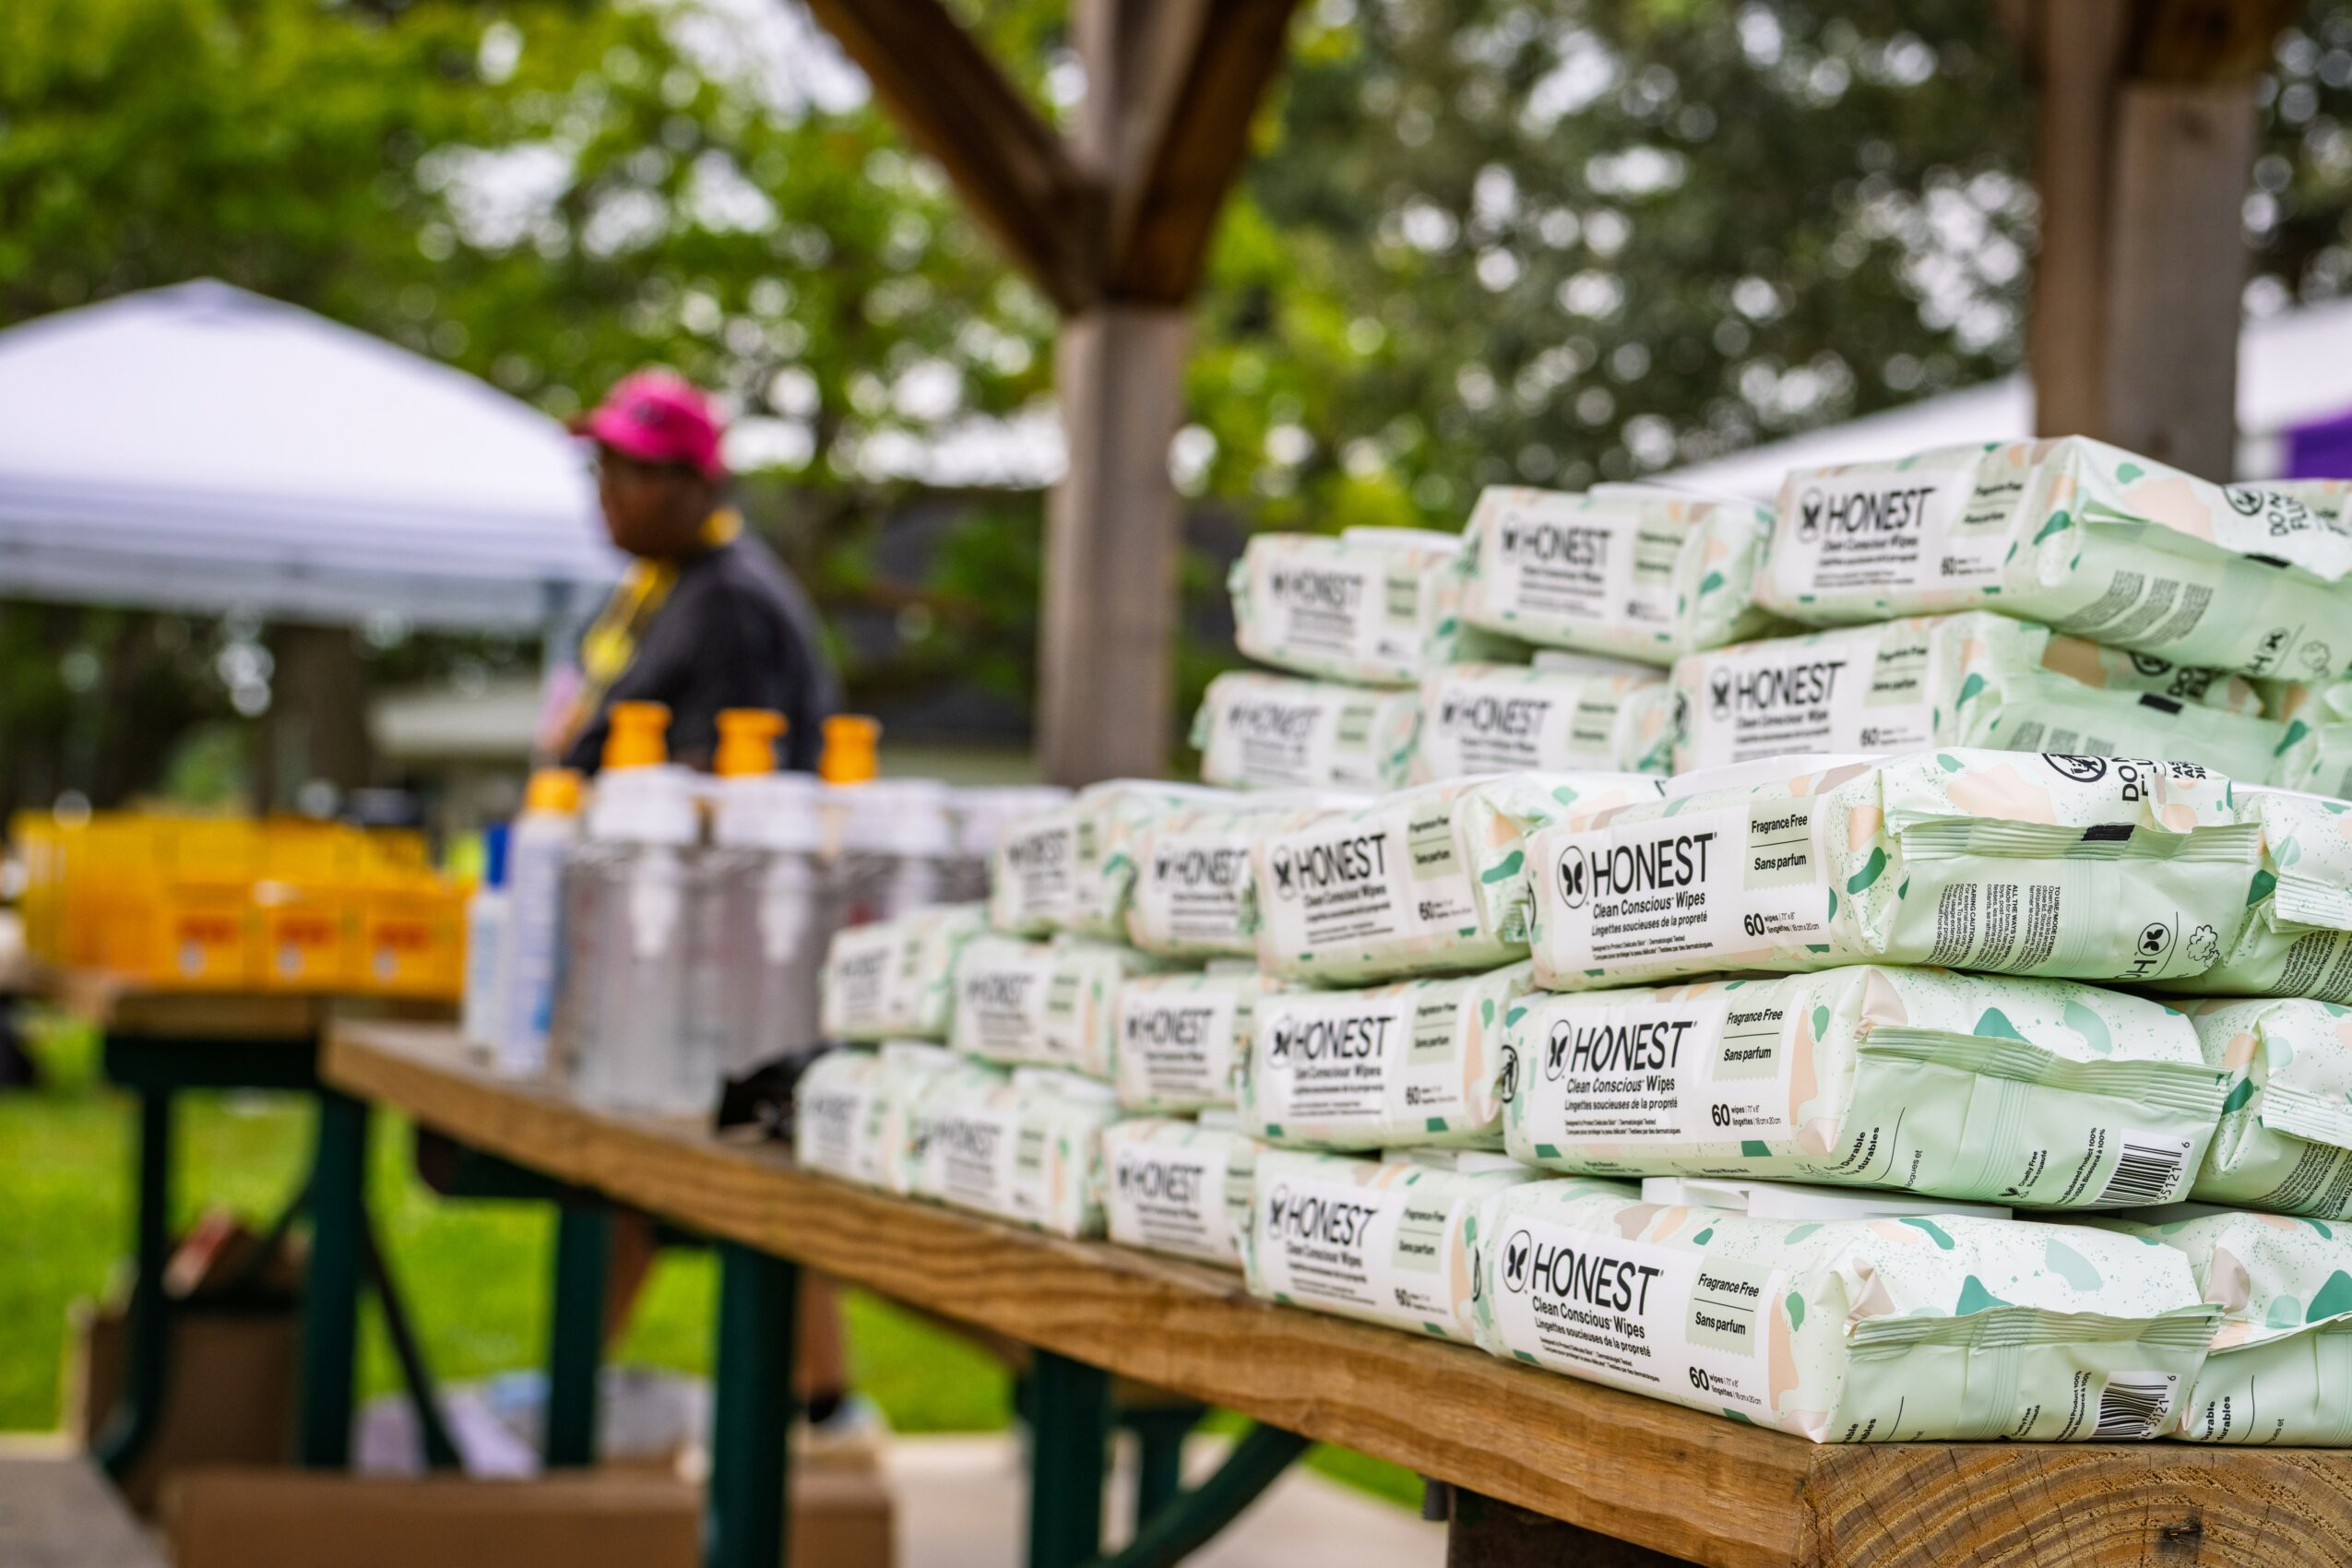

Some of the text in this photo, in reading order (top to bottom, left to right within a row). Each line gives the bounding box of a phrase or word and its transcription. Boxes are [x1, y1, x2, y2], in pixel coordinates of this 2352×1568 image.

[1825, 488, 1936, 532] HONEST
[1736, 661, 1847, 708] HONEST
[2119, 766, 2139, 802] DO
[1752, 814, 1808, 835] Fragrance Free
[1295, 833, 1386, 887] HONEST
[1591, 832, 1714, 897] HONEST
[1754, 853, 1807, 871] Sans parfum
[1593, 891, 1705, 919] Clean Conscious Wipes
[1592, 910, 1707, 937] Lingettes soucieuses de la propreté
[1744, 912, 1765, 937] 60
[1727, 1008, 1783, 1026] Fragrance Free
[1292, 1016, 1394, 1060] HONEST
[1571, 1021, 1693, 1072] HONEST
[1724, 1046, 1771, 1062] Sans parfum
[1567, 1075, 1674, 1094] Clean Conscious Wipes
[1565, 1097, 1678, 1112] Lingettes soucieuses de la propreté
[1712, 1103, 1730, 1127] 60
[1840, 1131, 1866, 1167] Durable
[1858, 1127, 1880, 1170] durables
[1915, 1149, 1922, 1158] et
[2029, 1151, 2037, 1167] Free
[2037, 1150, 2047, 1175] cruauté
[2079, 1147, 2094, 1171] Product
[2088, 1127, 2097, 1146] 100%
[2082, 1155, 2101, 1183] Biosourcé
[2097, 1128, 2106, 1148] 100%
[1286, 1196, 1378, 1248] HONEST
[1532, 1243, 1660, 1315] HONEST
[1698, 1273, 1759, 1297] Fragrance Free
[1533, 1296, 1645, 1338] Clean Conscious Wipes
[1695, 1311, 1746, 1335] Sans parfum
[1535, 1316, 1565, 1335] Lingettes
[1566, 1326, 1603, 1344] soucieuses
[1604, 1336, 1612, 1347] de
[1613, 1337, 1620, 1348] la
[1621, 1340, 1651, 1357] propreté
[1690, 1366, 1709, 1391] 60
[2070, 1389, 2078, 1418] Product
[2215, 1396, 2231, 1441] durables
